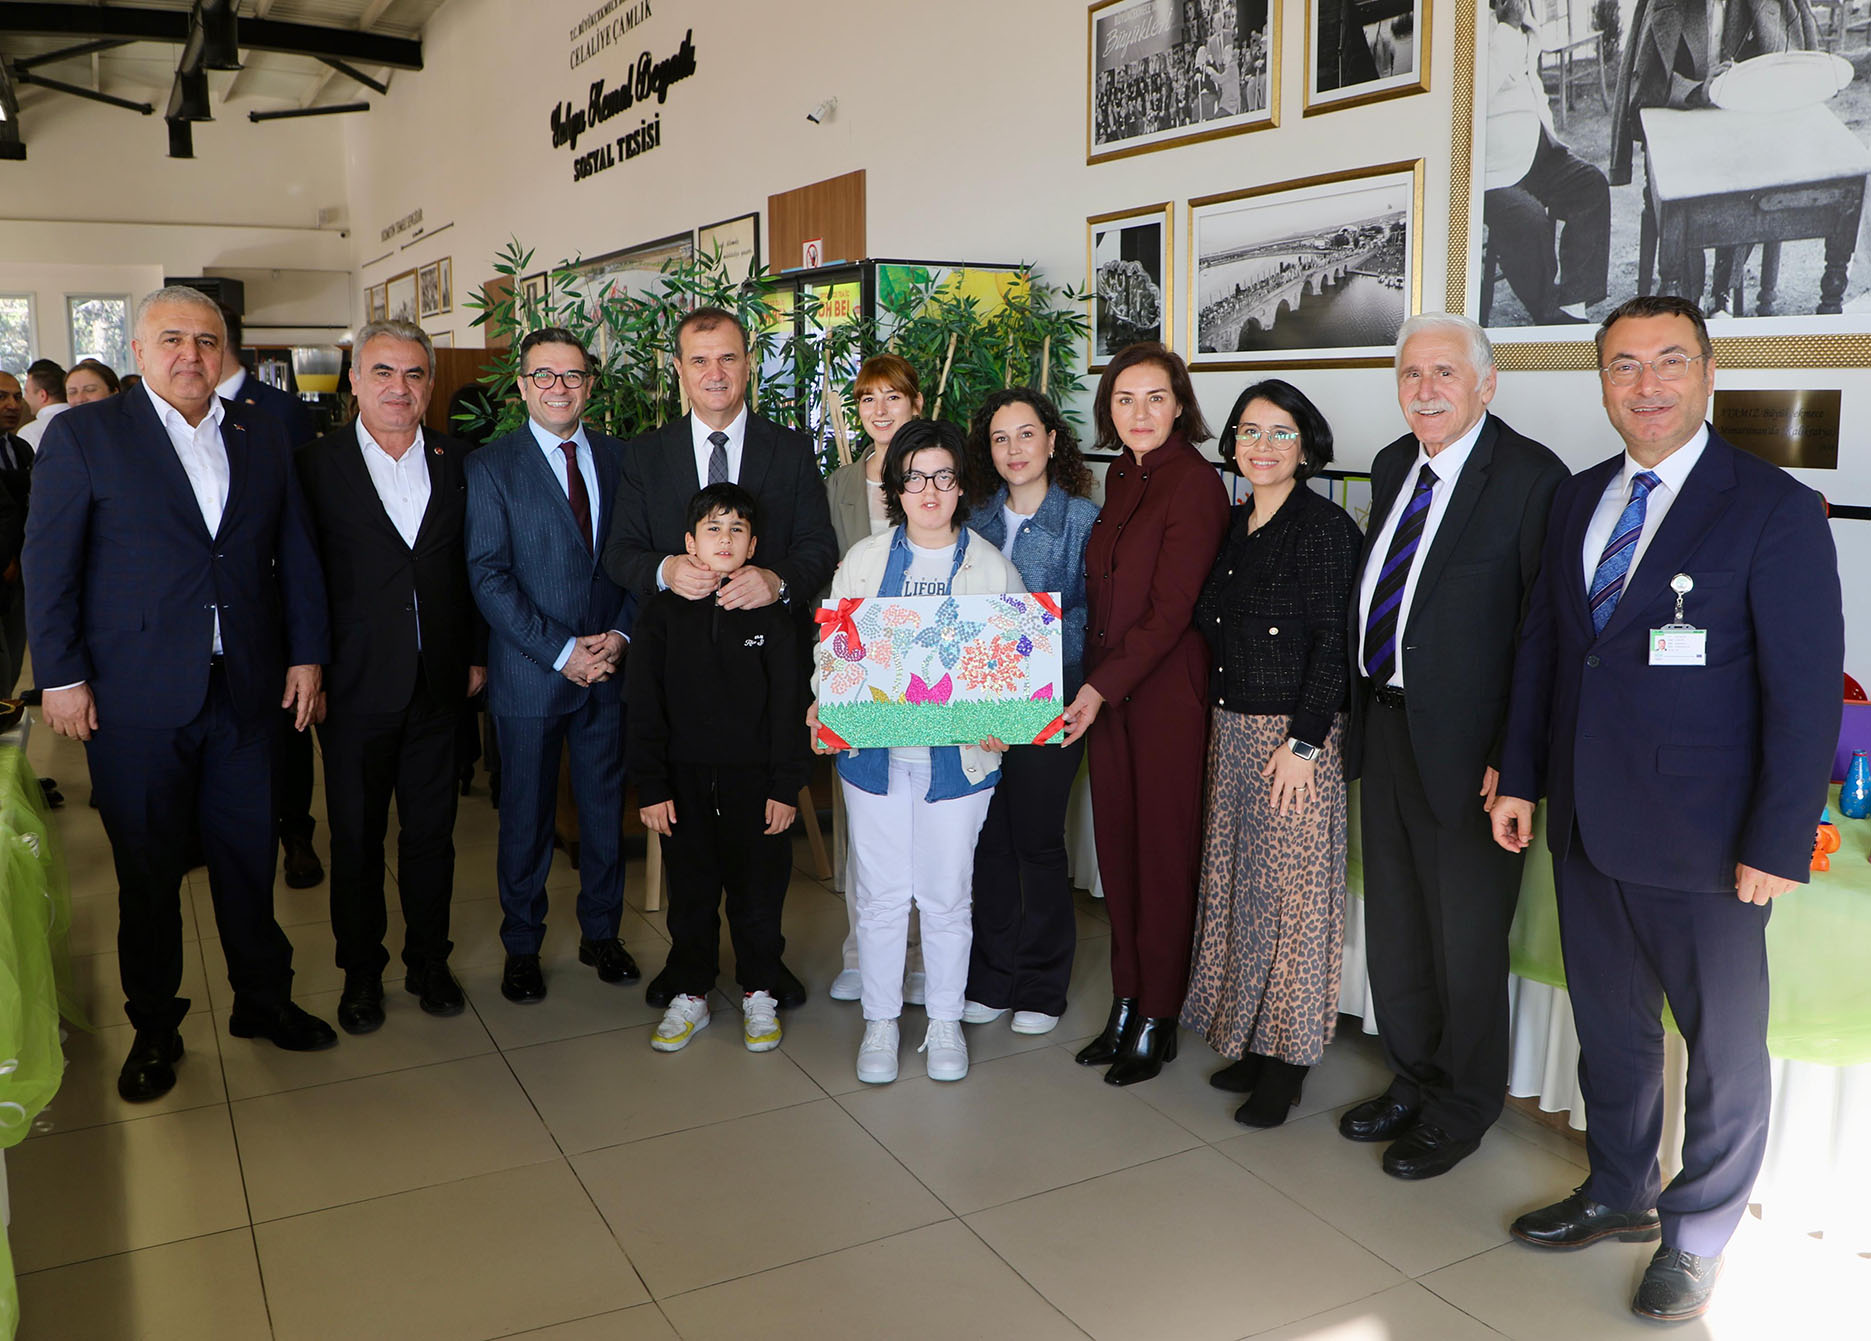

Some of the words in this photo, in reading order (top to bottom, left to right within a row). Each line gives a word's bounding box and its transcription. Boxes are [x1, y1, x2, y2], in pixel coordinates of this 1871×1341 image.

[570, 27, 611, 70] CELALİYE
[613, 0, 652, 45] ÇAMLIK
[574, 144, 615, 182] SOSYAL
[617, 112, 661, 162] TESİSİ
